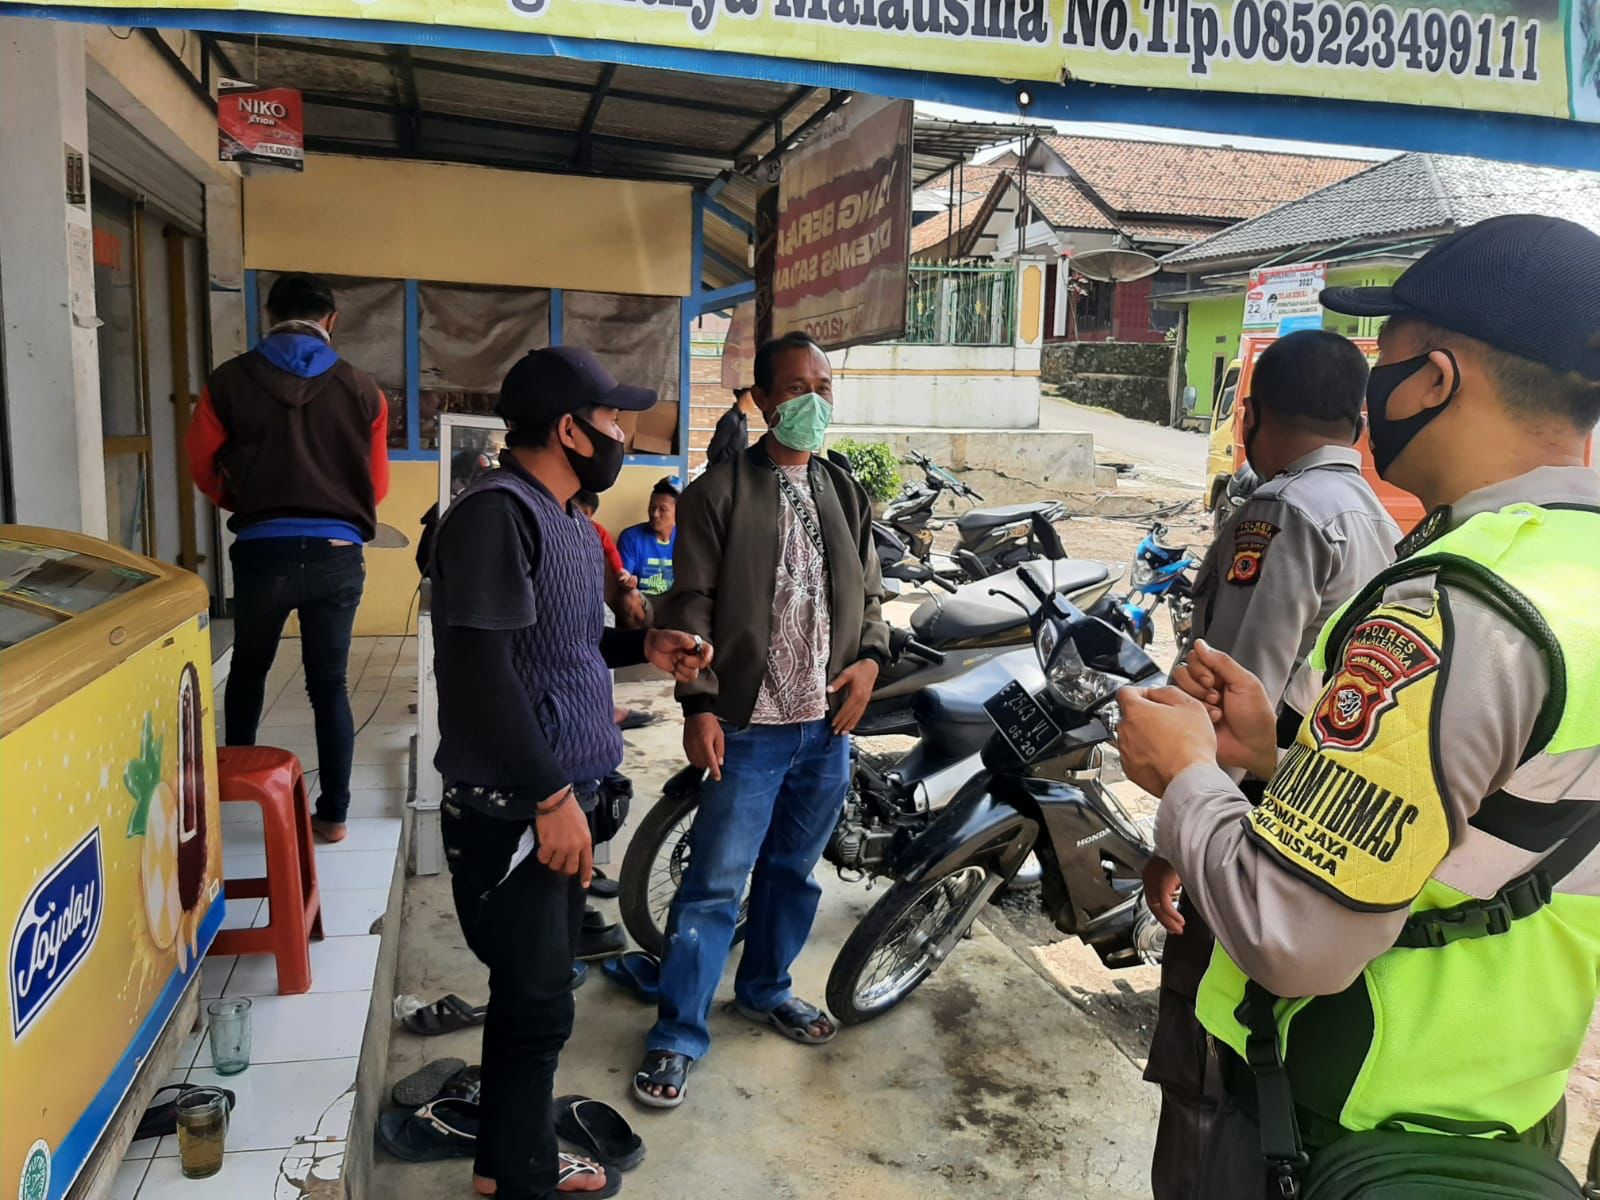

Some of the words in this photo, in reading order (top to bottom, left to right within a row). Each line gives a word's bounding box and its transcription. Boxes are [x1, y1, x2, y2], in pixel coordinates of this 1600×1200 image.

[239, 97, 287, 118] NIKO
[1247, 303, 1261, 314] 22
[1365, 625, 1417, 654] POLRES
[1008, 692, 1036, 722] 2543
[1031, 719, 1050, 742] VL
[1076, 827, 1111, 848] HONDA
[1305, 823, 1349, 861] JAYA
[17, 879, 95, 998] Joyday
